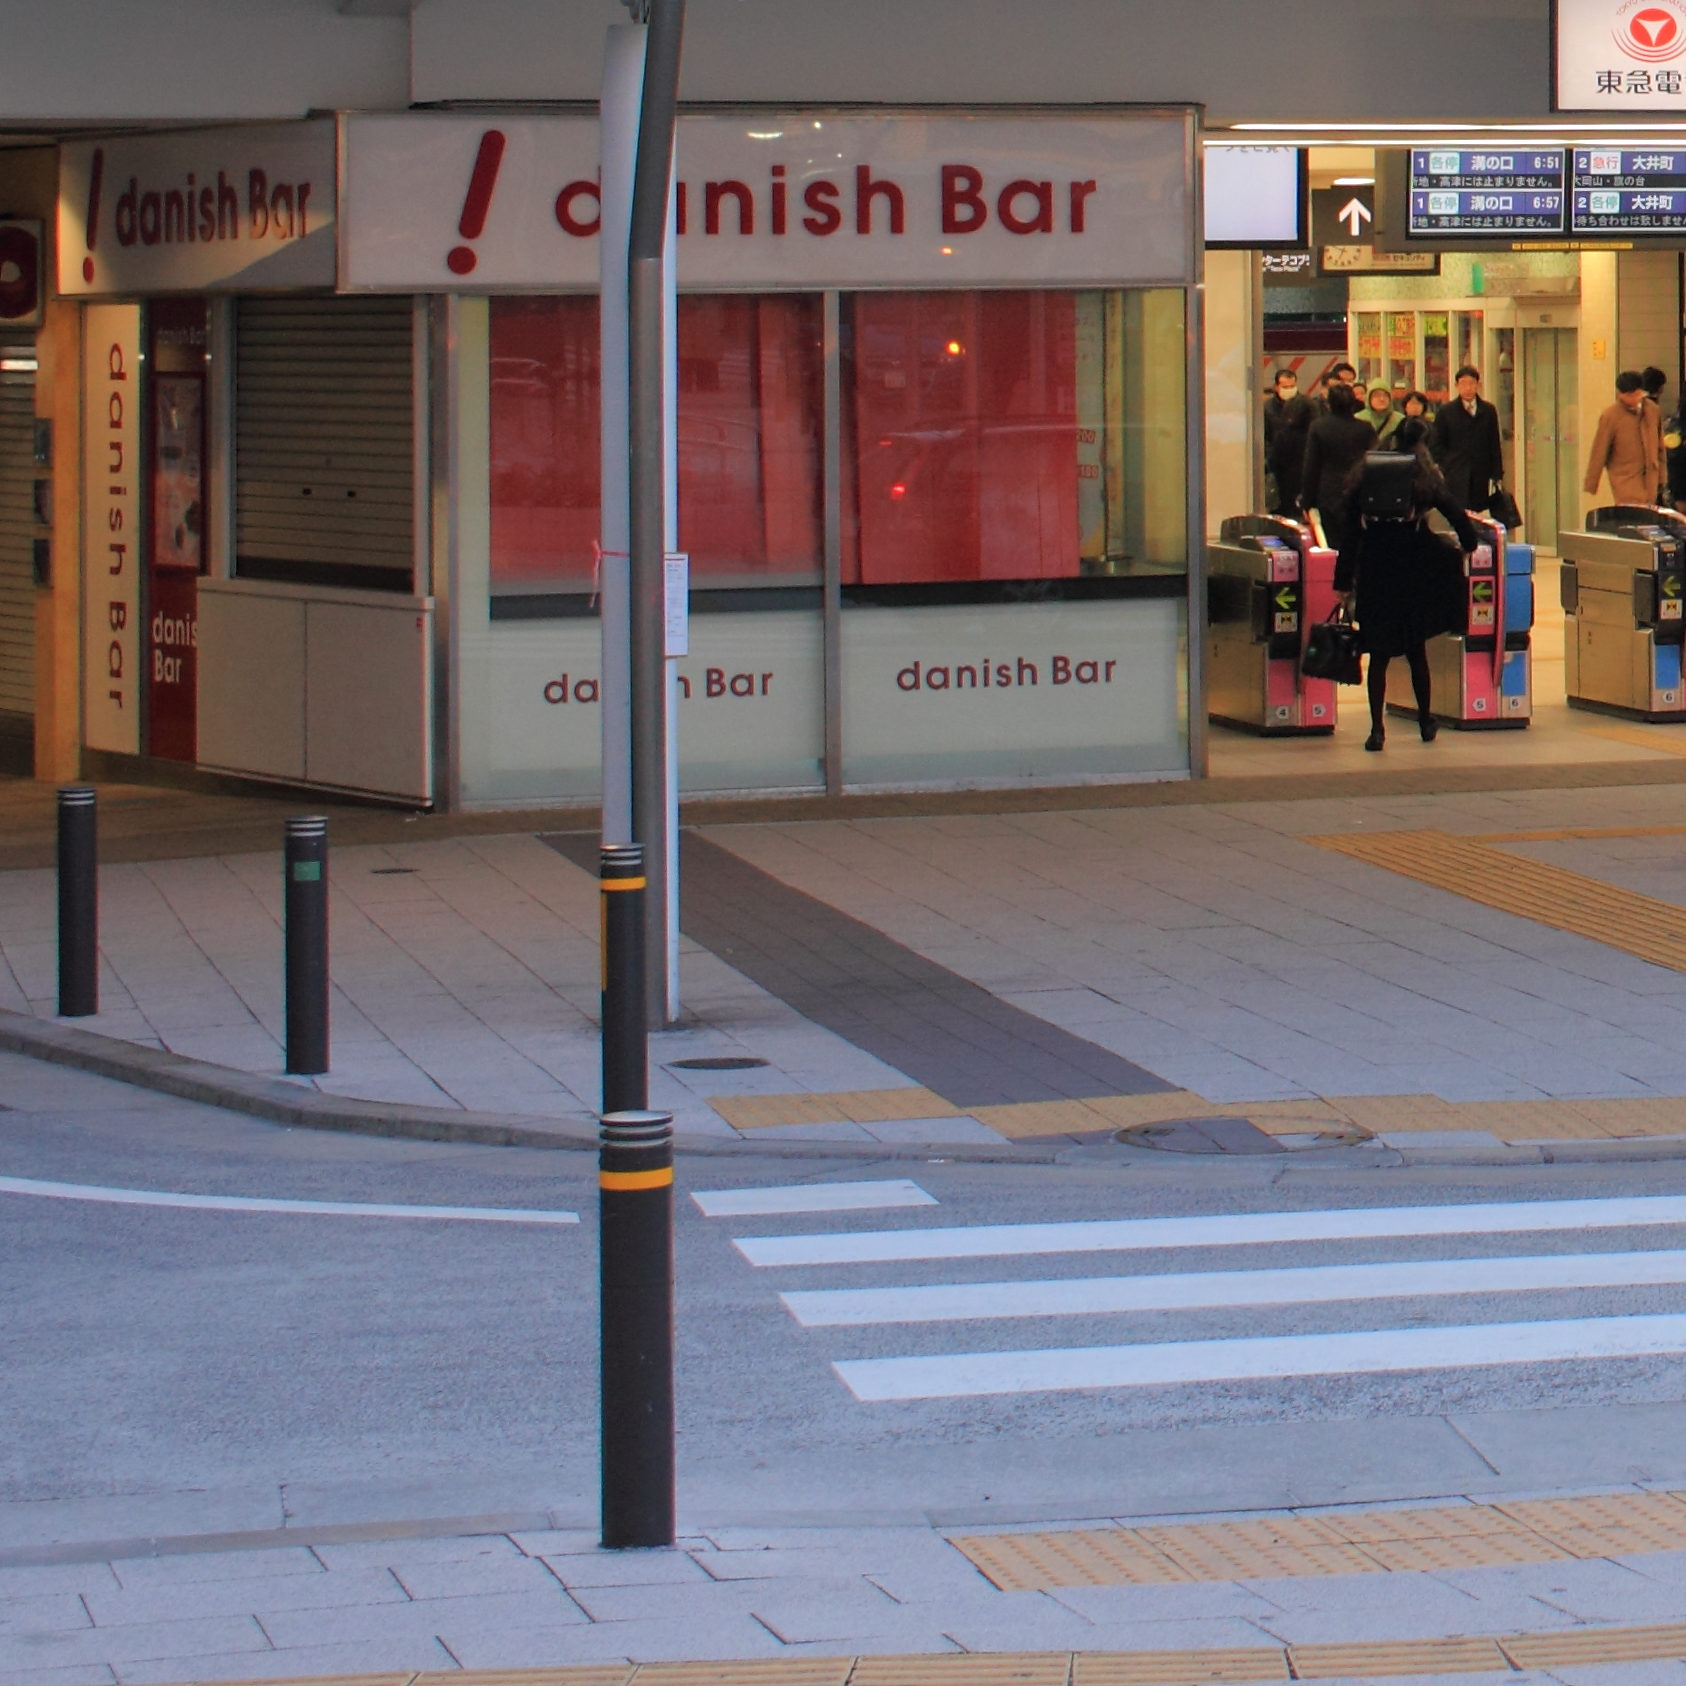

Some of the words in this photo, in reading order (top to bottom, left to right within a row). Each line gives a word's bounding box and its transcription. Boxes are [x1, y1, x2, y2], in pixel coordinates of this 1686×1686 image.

[1418, 157, 1425, 168] 1
[1431, 156, 1459, 170] 各停
[1471, 155, 1514, 171] 溝の口
[1534, 156, 1560, 168] 6:51
[1578, 157, 1587, 168] 2
[1592, 156, 1618, 170] 急行
[1632, 155, 1674, 171] 大井町
[115, 170, 239, 247] danish
[249, 168, 312, 240] Bar
[554, 165, 905, 237] dnish
[941, 165, 1097, 234] Bar
[1417, 198, 1424, 209] 1
[1430, 196, 1458, 210] 各停
[1470, 195, 1513, 211] 溝の口
[1533, 196, 1560, 209] 6:57
[1577, 197, 1587, 208] 2
[1591, 196, 1617, 209] 各停
[1631, 195, 1673, 210] 大井町
[109, 343, 127, 576] danish
[152, 610, 197, 646] danis
[109, 602, 127, 709] Bar
[155, 649, 183, 684] Bar
[897, 656, 1038, 691] danish
[1052, 655, 1116, 685] Bar
[706, 667, 774, 698] Bar
